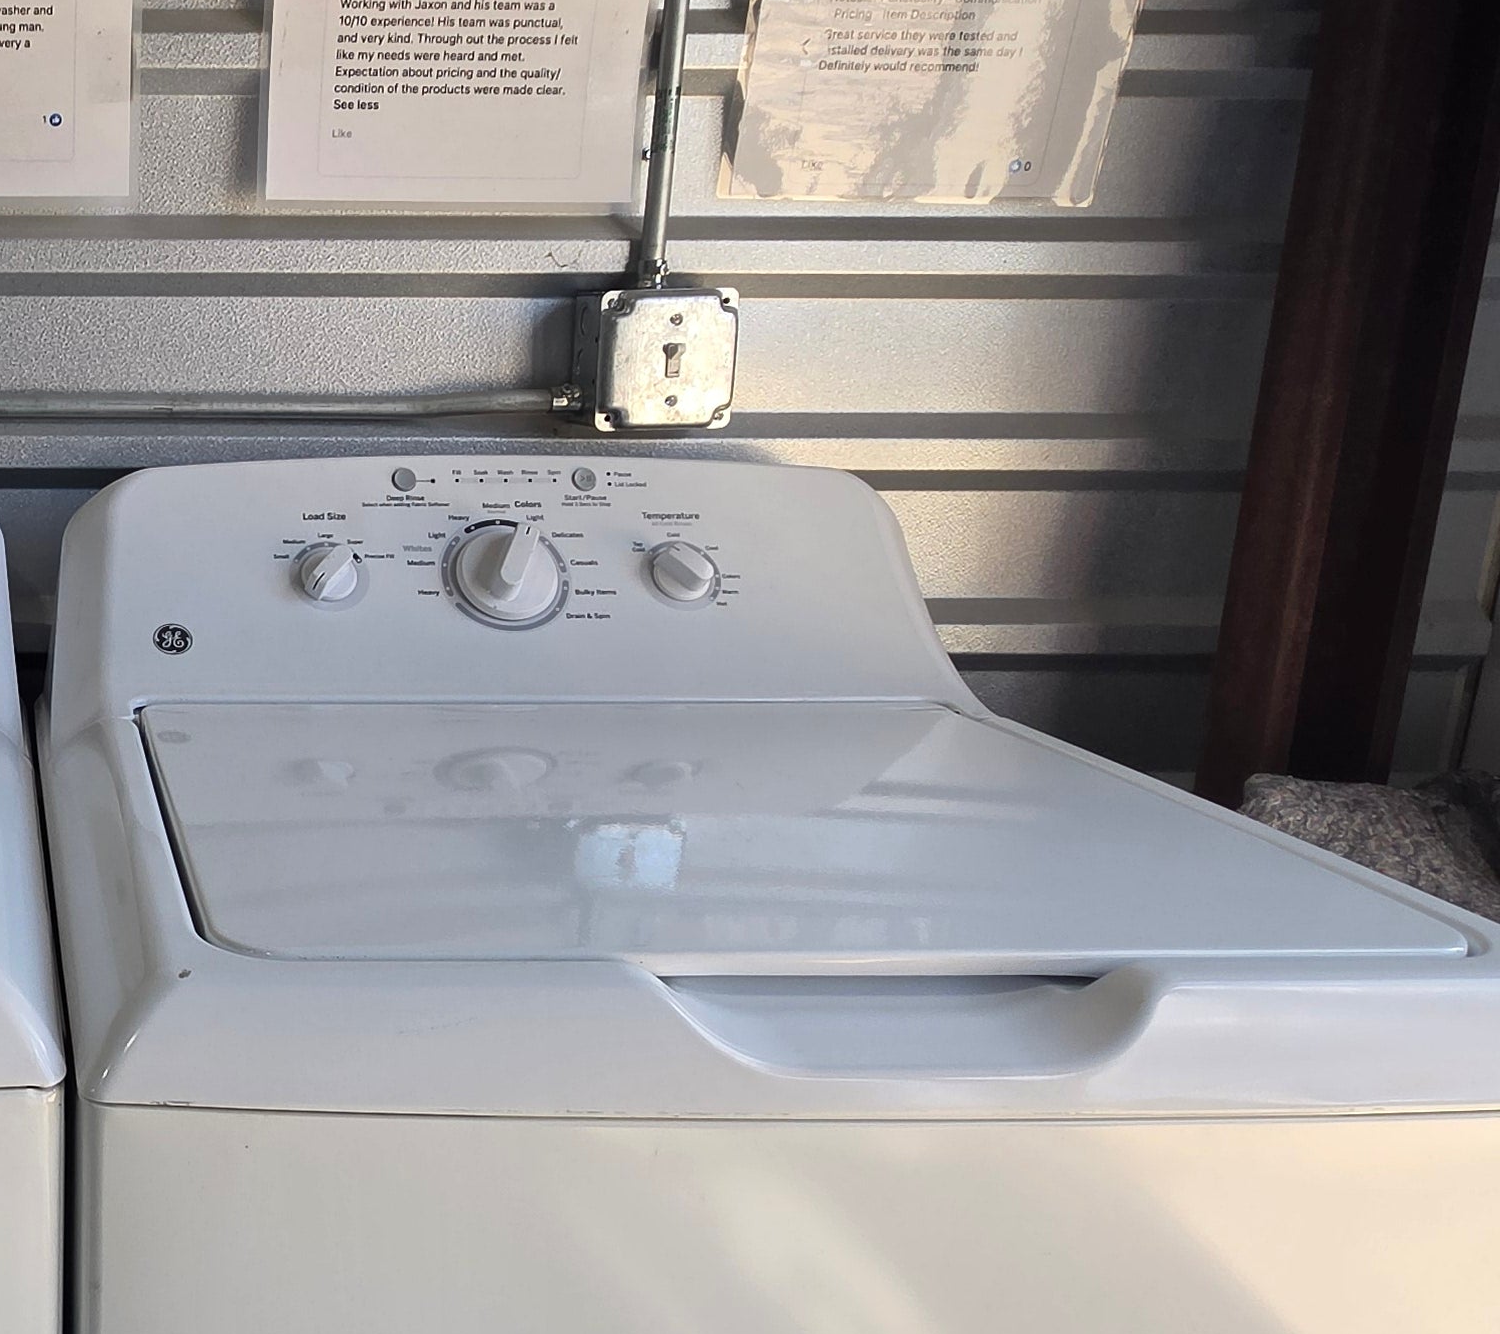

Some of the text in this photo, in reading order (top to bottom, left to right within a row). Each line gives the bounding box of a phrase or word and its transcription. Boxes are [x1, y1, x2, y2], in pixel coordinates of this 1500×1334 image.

[389, 0, 411, 9] with
[415, 0, 447, 9] Jaxon
[451, 0, 471, 10] and
[474, 0, 490, 10] his
[494, 1, 520, 10] team
[524, 2, 545, 10] was
[34, 6, 53, 15] and
